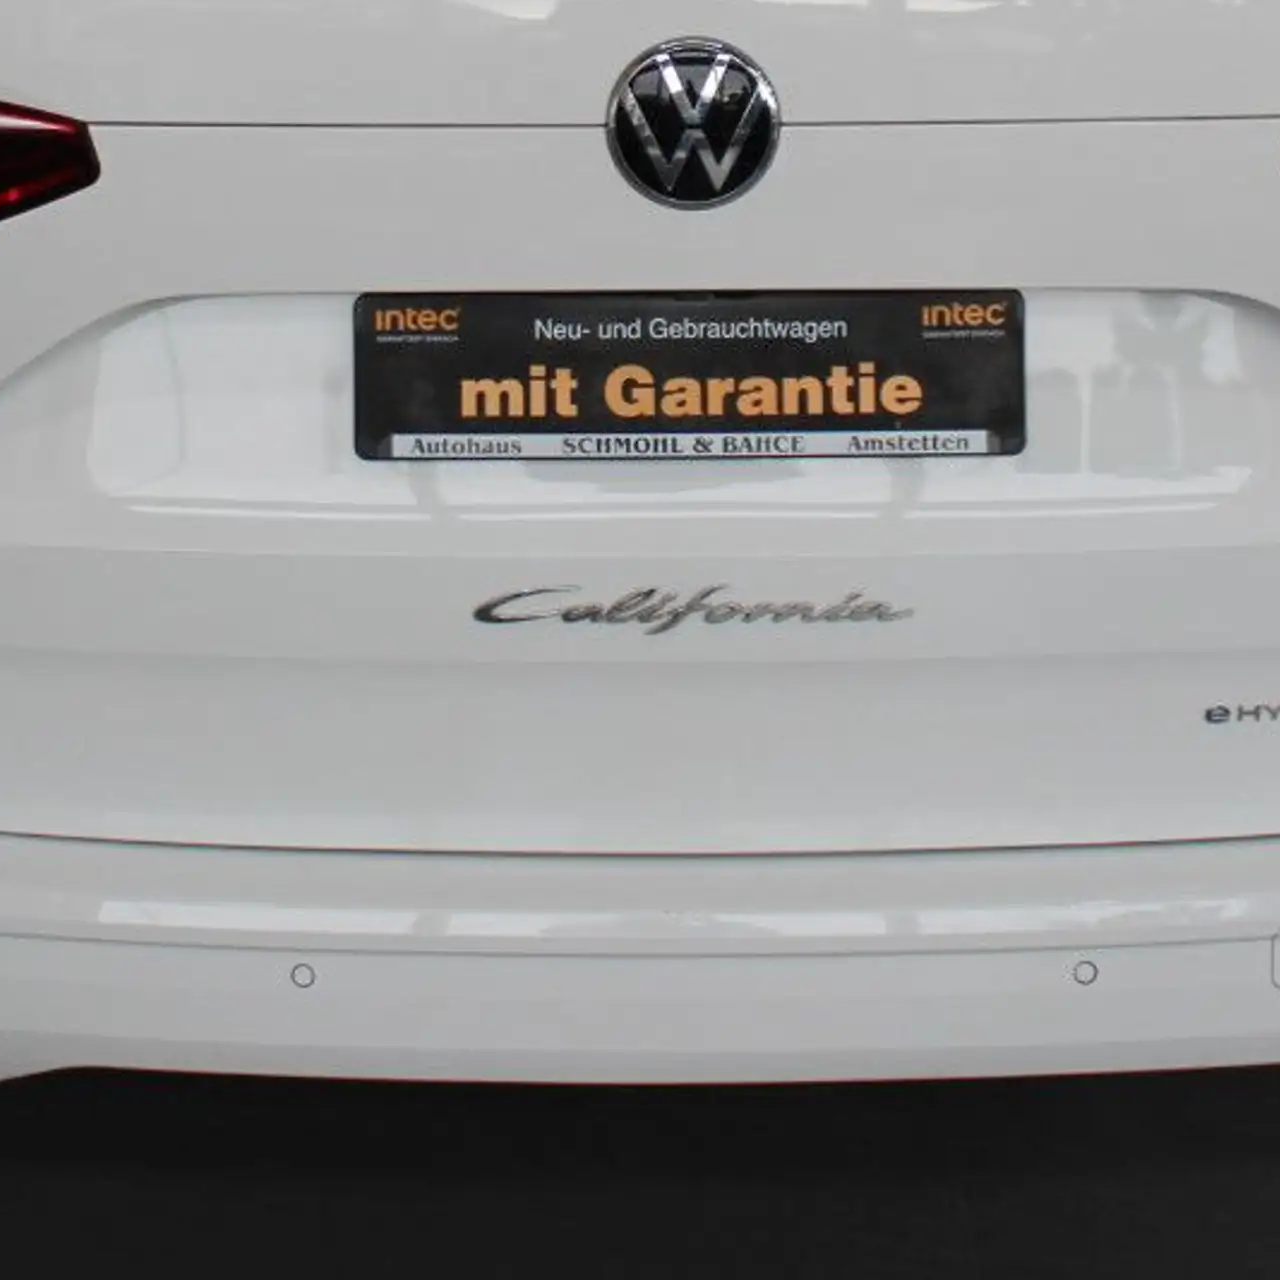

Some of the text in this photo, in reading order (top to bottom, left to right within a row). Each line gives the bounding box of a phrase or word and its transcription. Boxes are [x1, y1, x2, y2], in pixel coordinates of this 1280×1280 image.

[617, 51, 769, 193] VW
[375, 307, 458, 332] intec
[921, 302, 1006, 327] intec
[534, 317, 848, 343] Neu- und Gebrauchtwagen
[460, 361, 923, 418] mit Garantie
[411, 434, 969, 455] Autohaus SCHMOHL & BAHCE Amstetten
[473, 583, 915, 635] California
